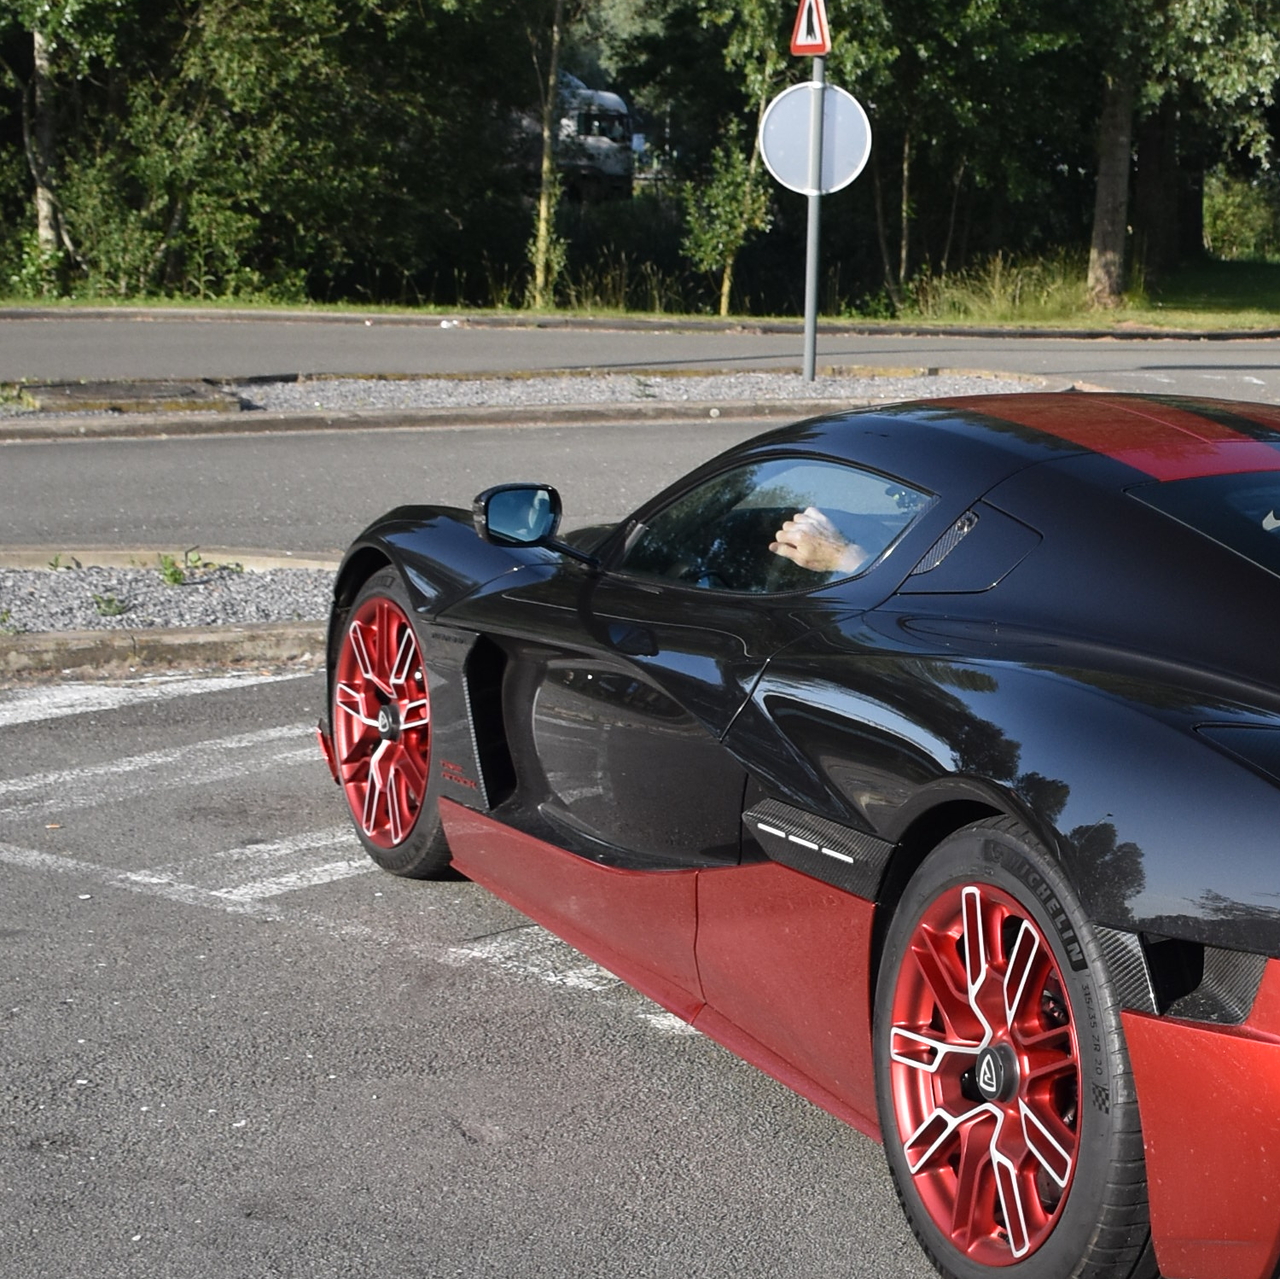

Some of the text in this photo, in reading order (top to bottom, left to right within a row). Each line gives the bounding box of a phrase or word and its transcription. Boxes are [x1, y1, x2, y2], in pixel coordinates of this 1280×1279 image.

[1081, 983, 1103, 1076] 315/35 ZR 20
